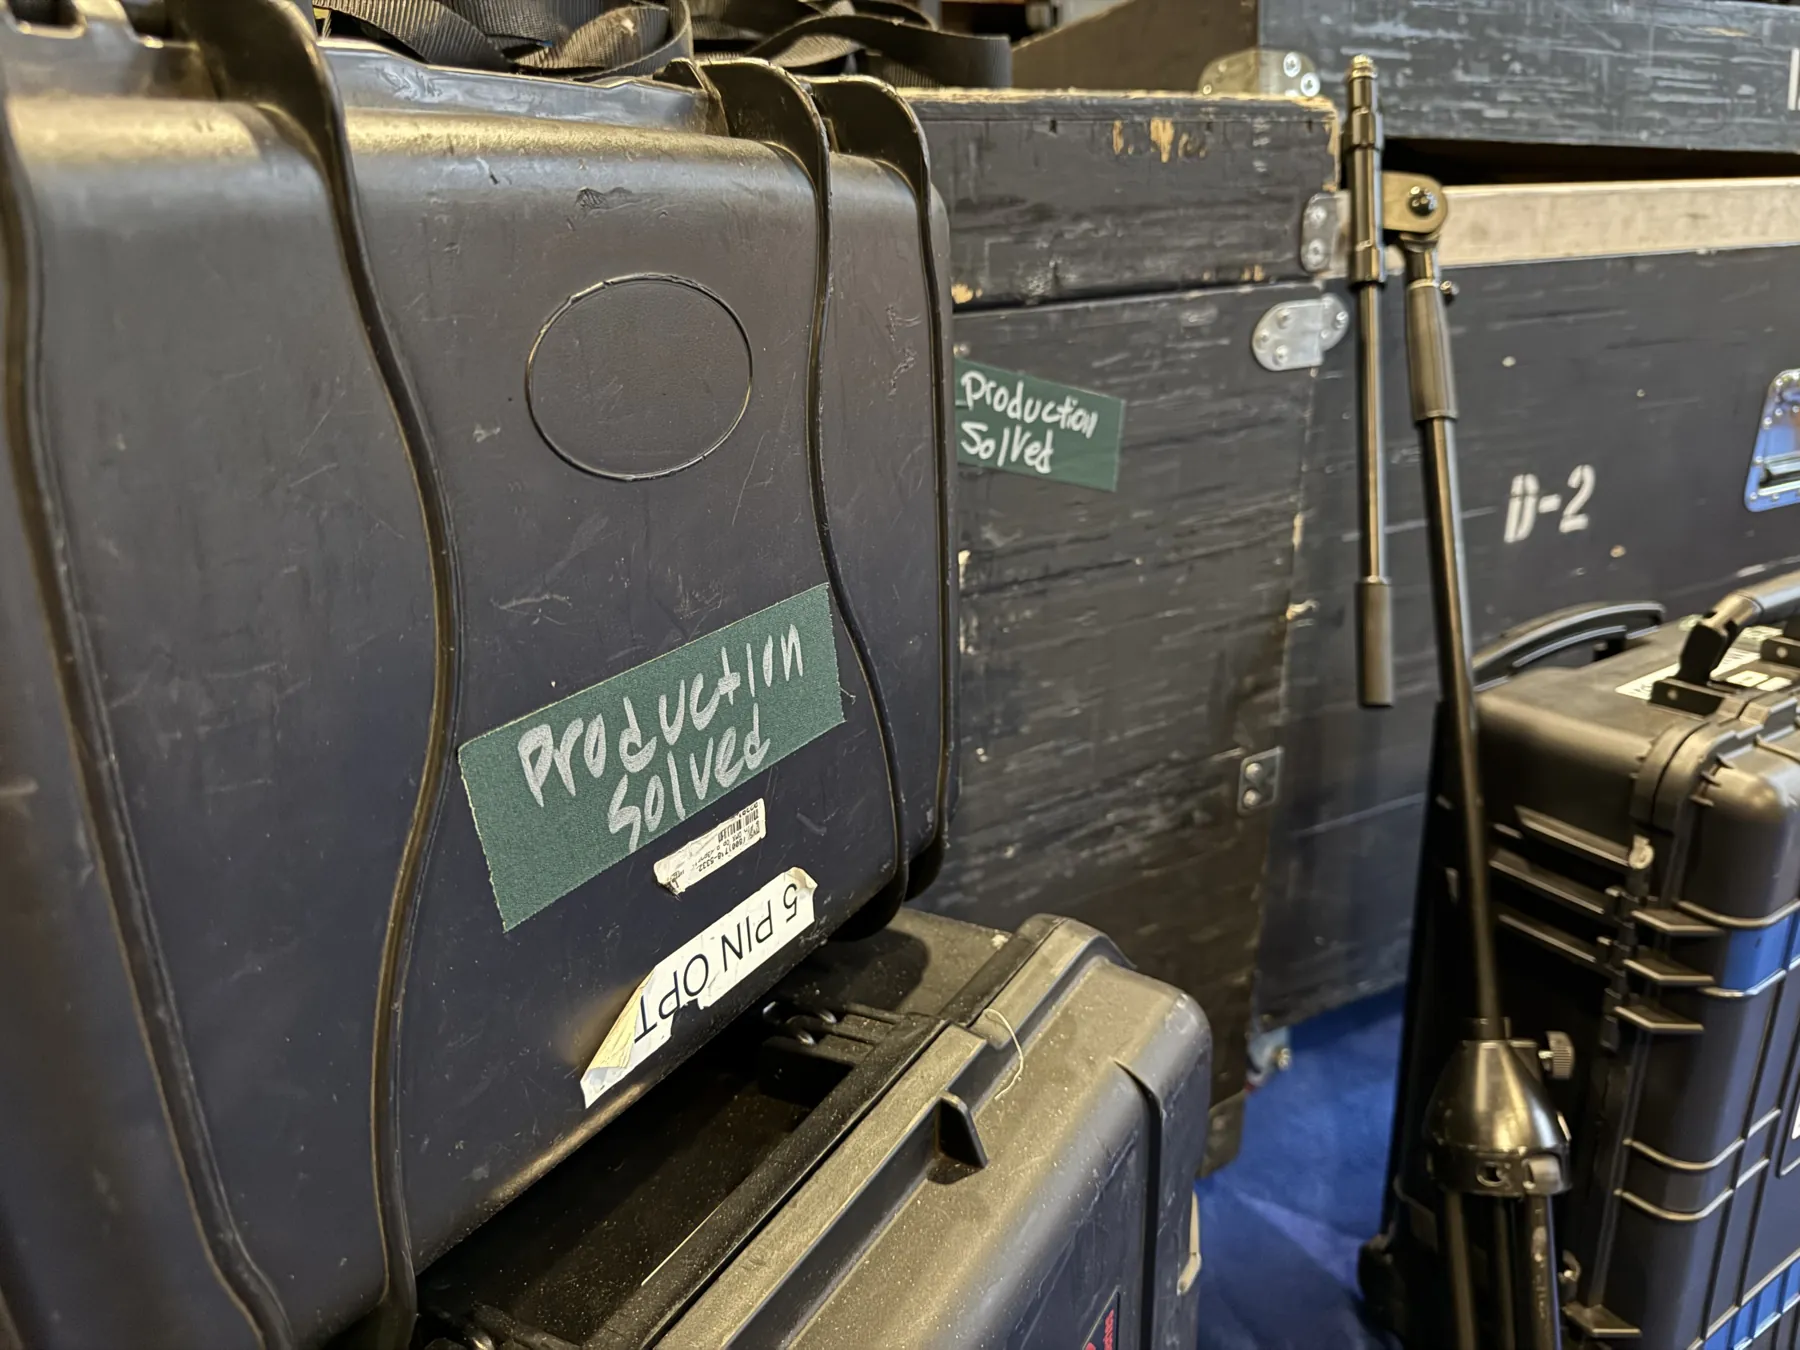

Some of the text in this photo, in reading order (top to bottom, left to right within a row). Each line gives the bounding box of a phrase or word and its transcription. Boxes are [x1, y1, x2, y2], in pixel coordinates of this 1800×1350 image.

[960, 370, 1099, 440] Production
[960, 421, 1054, 474] Solved
[1504, 464, 1596, 543] D-2
[607, 702, 771, 852] Solved
[634, 883, 798, 1044] 5 PIN OPT
